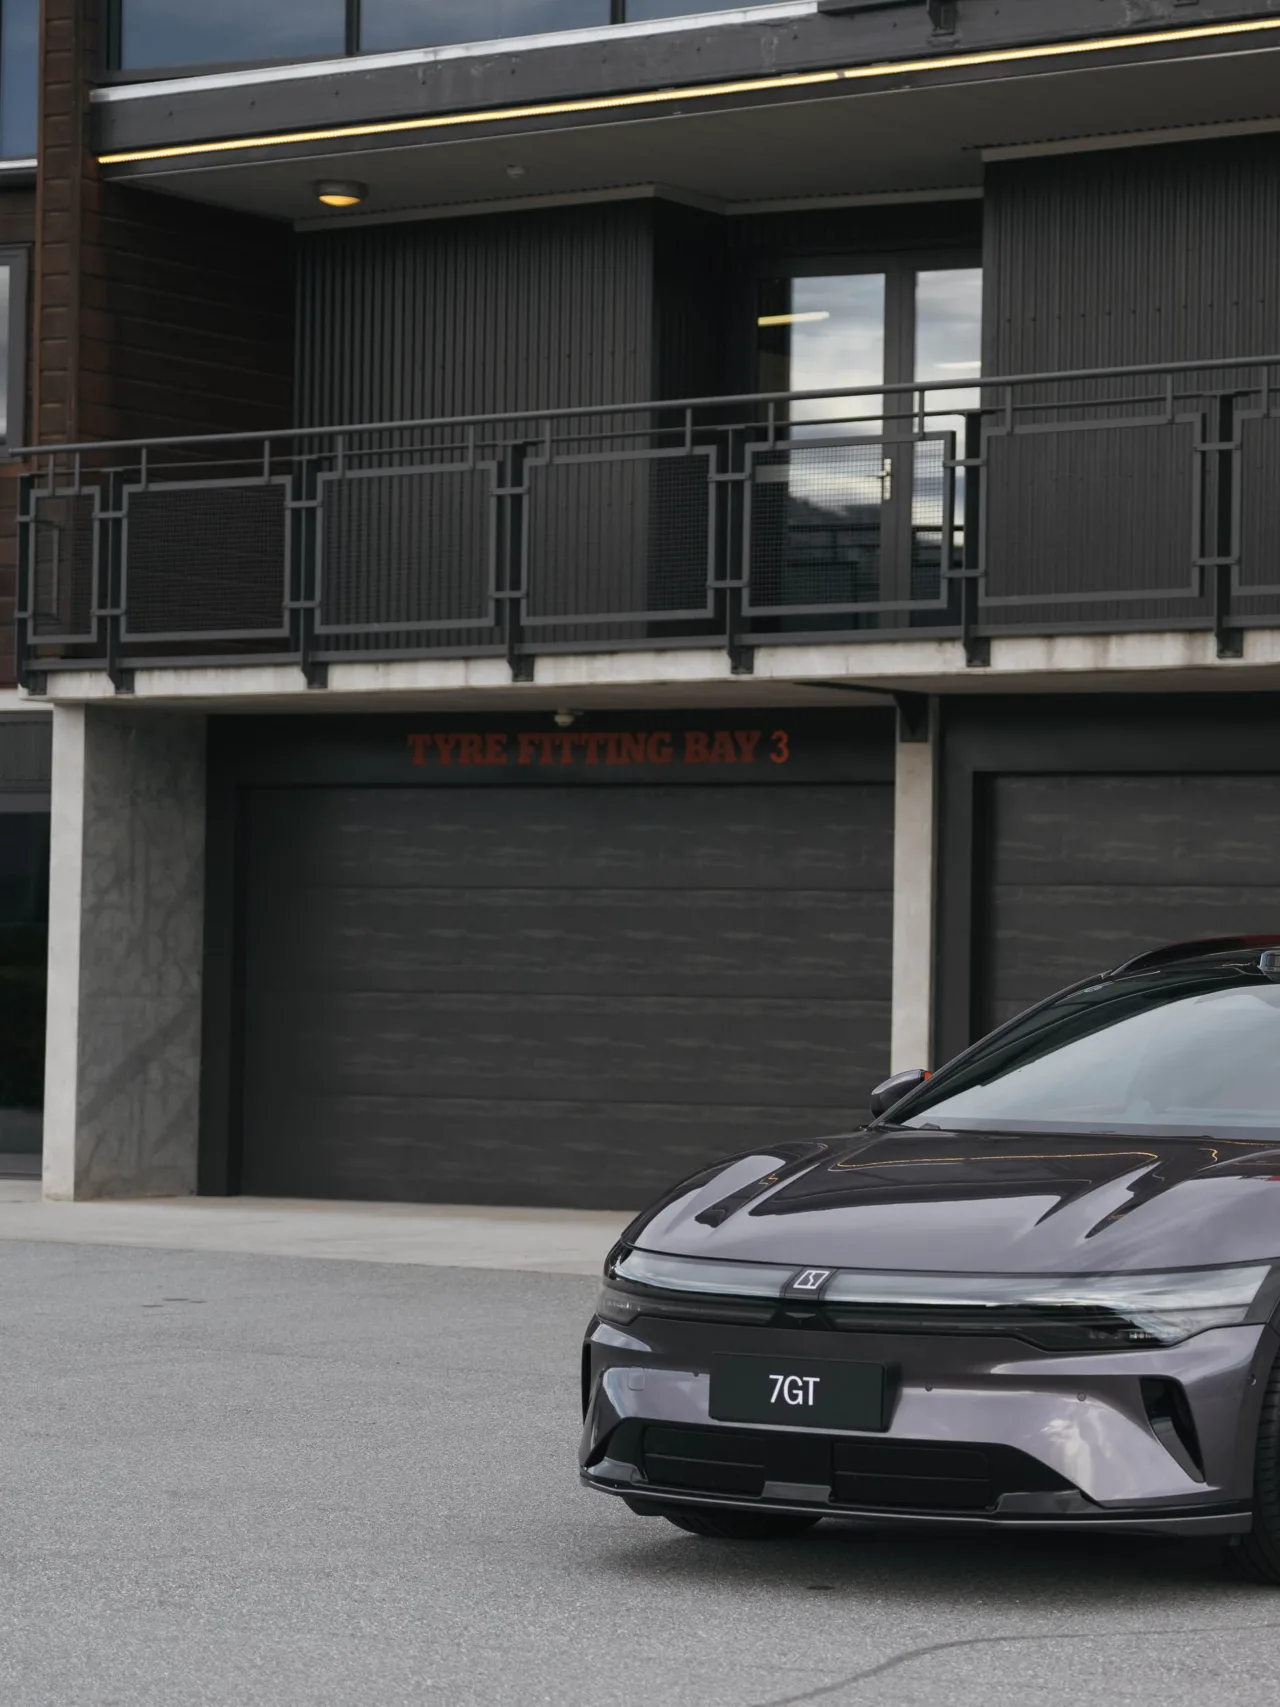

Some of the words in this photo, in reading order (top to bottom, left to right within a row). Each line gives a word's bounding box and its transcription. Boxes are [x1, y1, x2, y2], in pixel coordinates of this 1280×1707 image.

[407, 731, 508, 766] TYRE
[516, 731, 674, 765] FITTING
[683, 730, 762, 764] BAY
[769, 729, 791, 764] 3
[768, 1374, 821, 1406] 7GT
